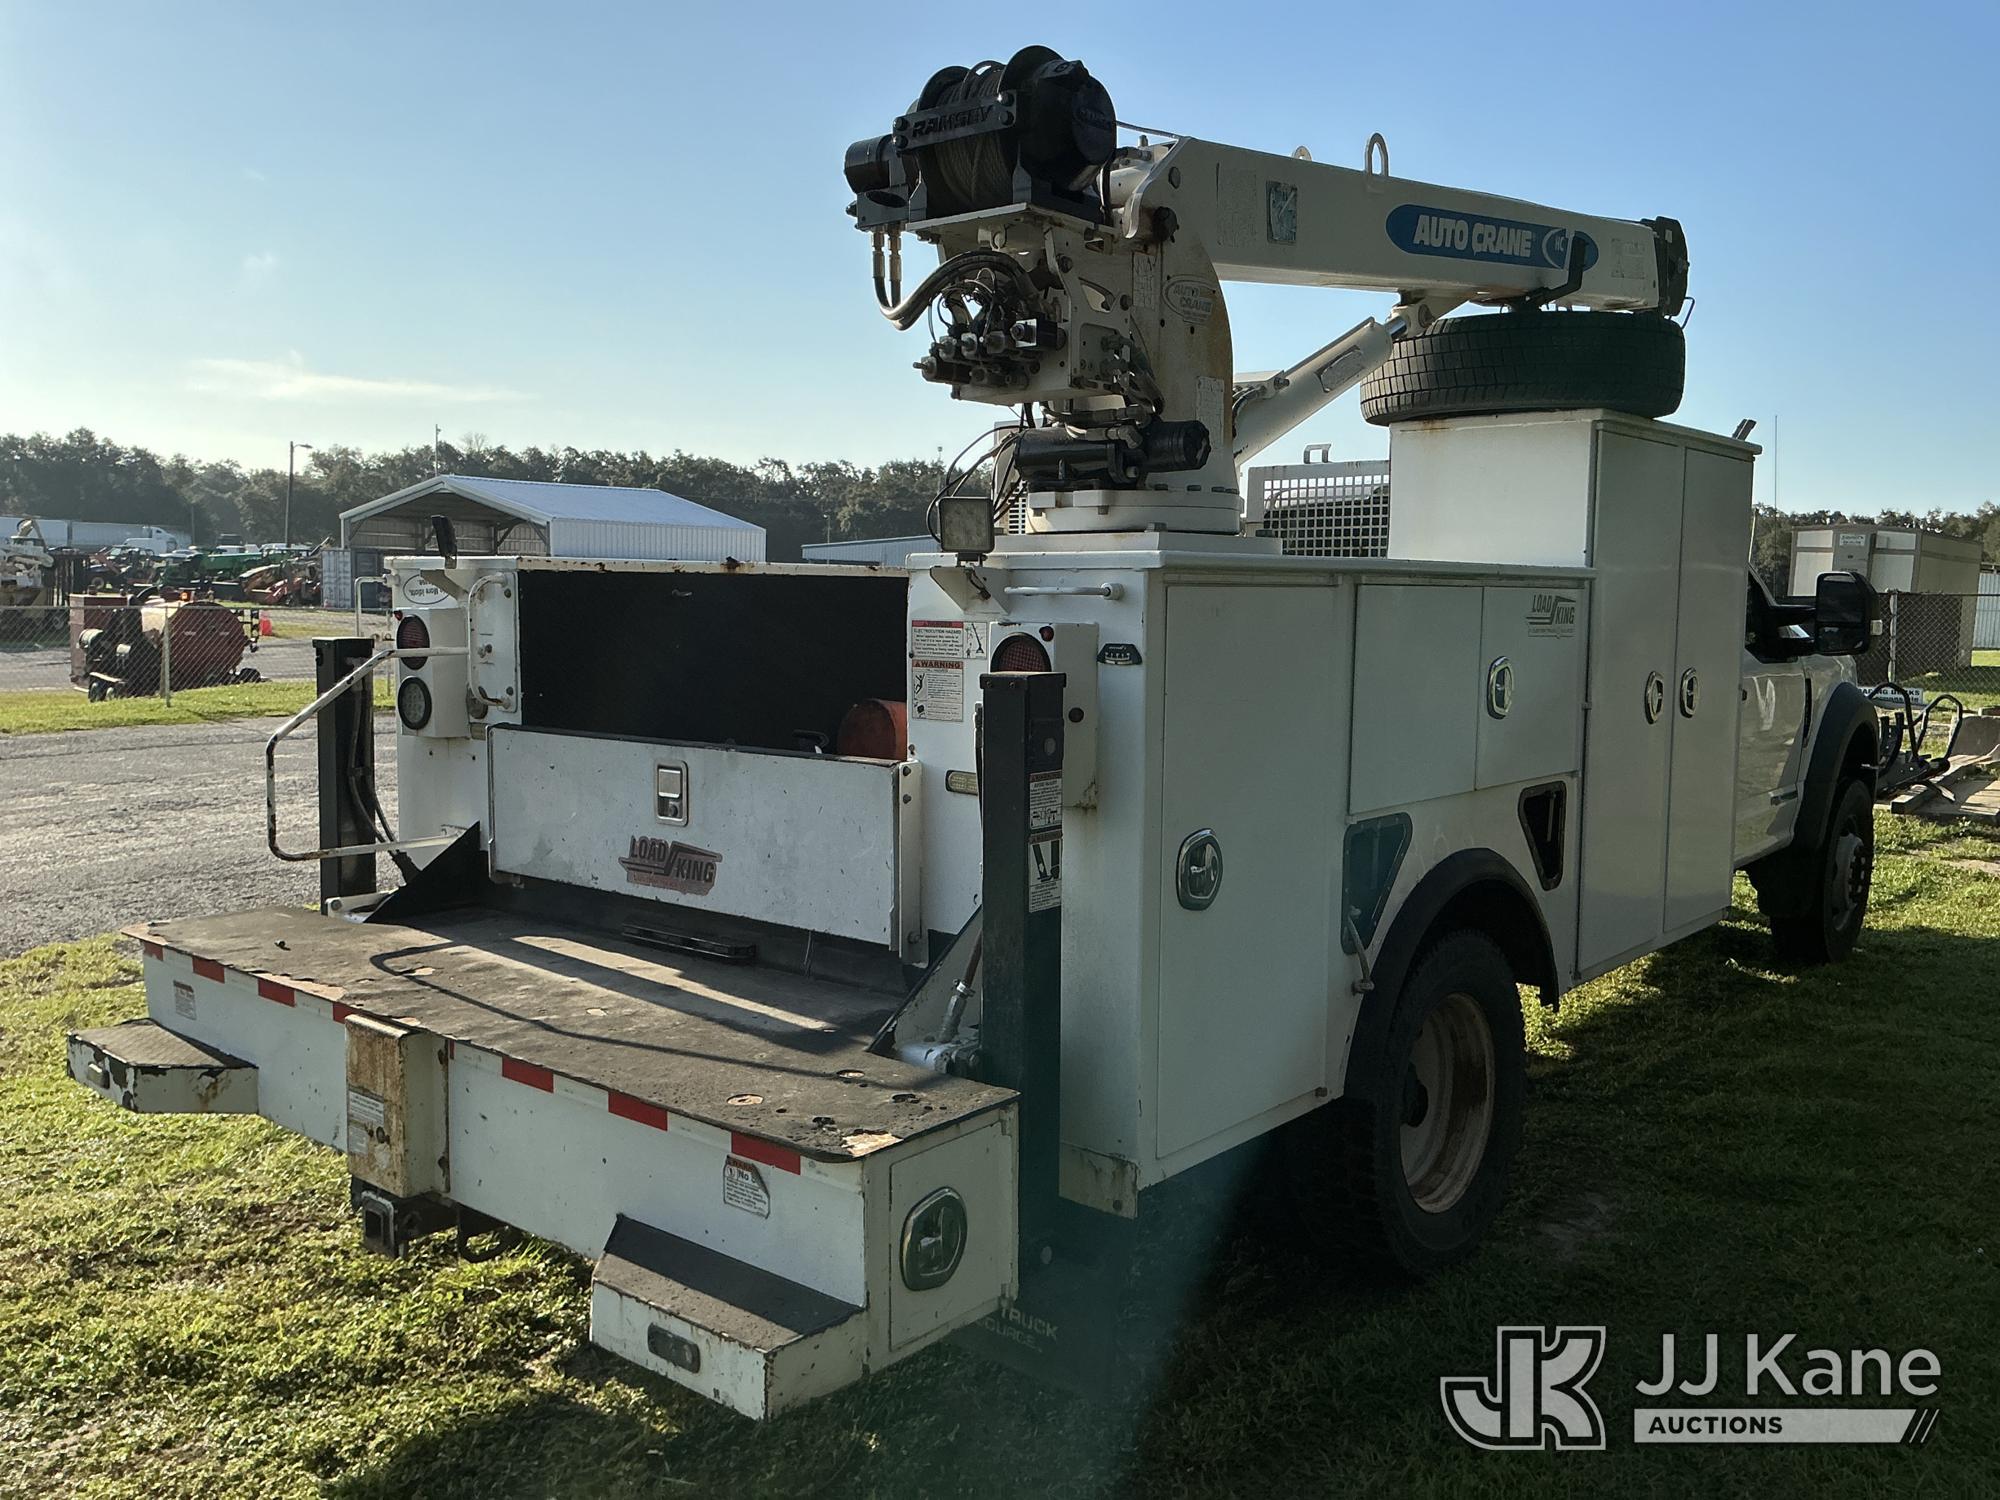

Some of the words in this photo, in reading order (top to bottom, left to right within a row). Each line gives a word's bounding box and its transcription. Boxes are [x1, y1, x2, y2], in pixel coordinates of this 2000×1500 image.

[1413, 214, 1469, 251] AUTO
[1472, 222, 1533, 258] CRANE
[1532, 594, 1553, 613] LOAD
[1555, 606, 1575, 624] KING
[921, 660, 960, 669] WARNING
[630, 837, 667, 862] LOAD
[676, 858, 715, 883] KING
